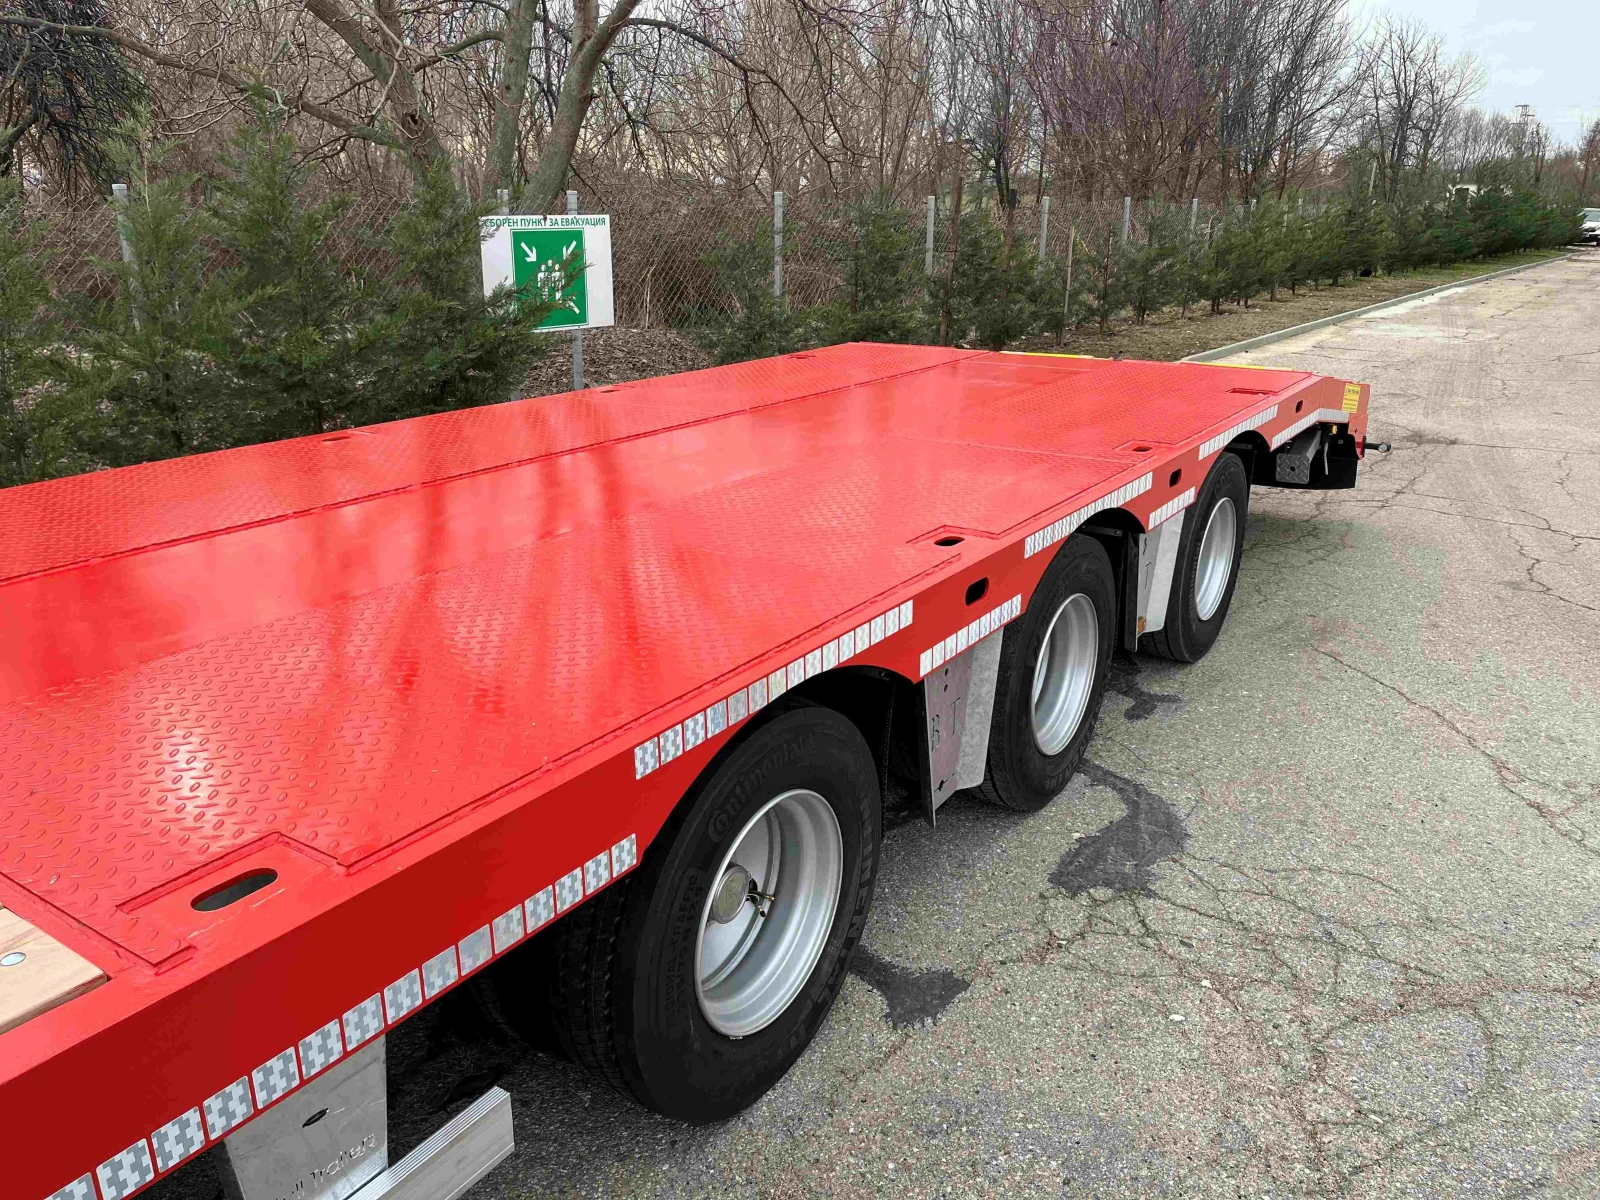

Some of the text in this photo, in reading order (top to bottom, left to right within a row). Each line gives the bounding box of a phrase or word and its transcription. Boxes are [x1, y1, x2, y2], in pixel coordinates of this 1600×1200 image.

[484, 217, 519, 228] СБОРЕН
[549, 217, 560, 227] ЗА
[561, 216, 606, 228] ЕВАКУАЦИЯ
[309, 1133, 378, 1188] Trailers
